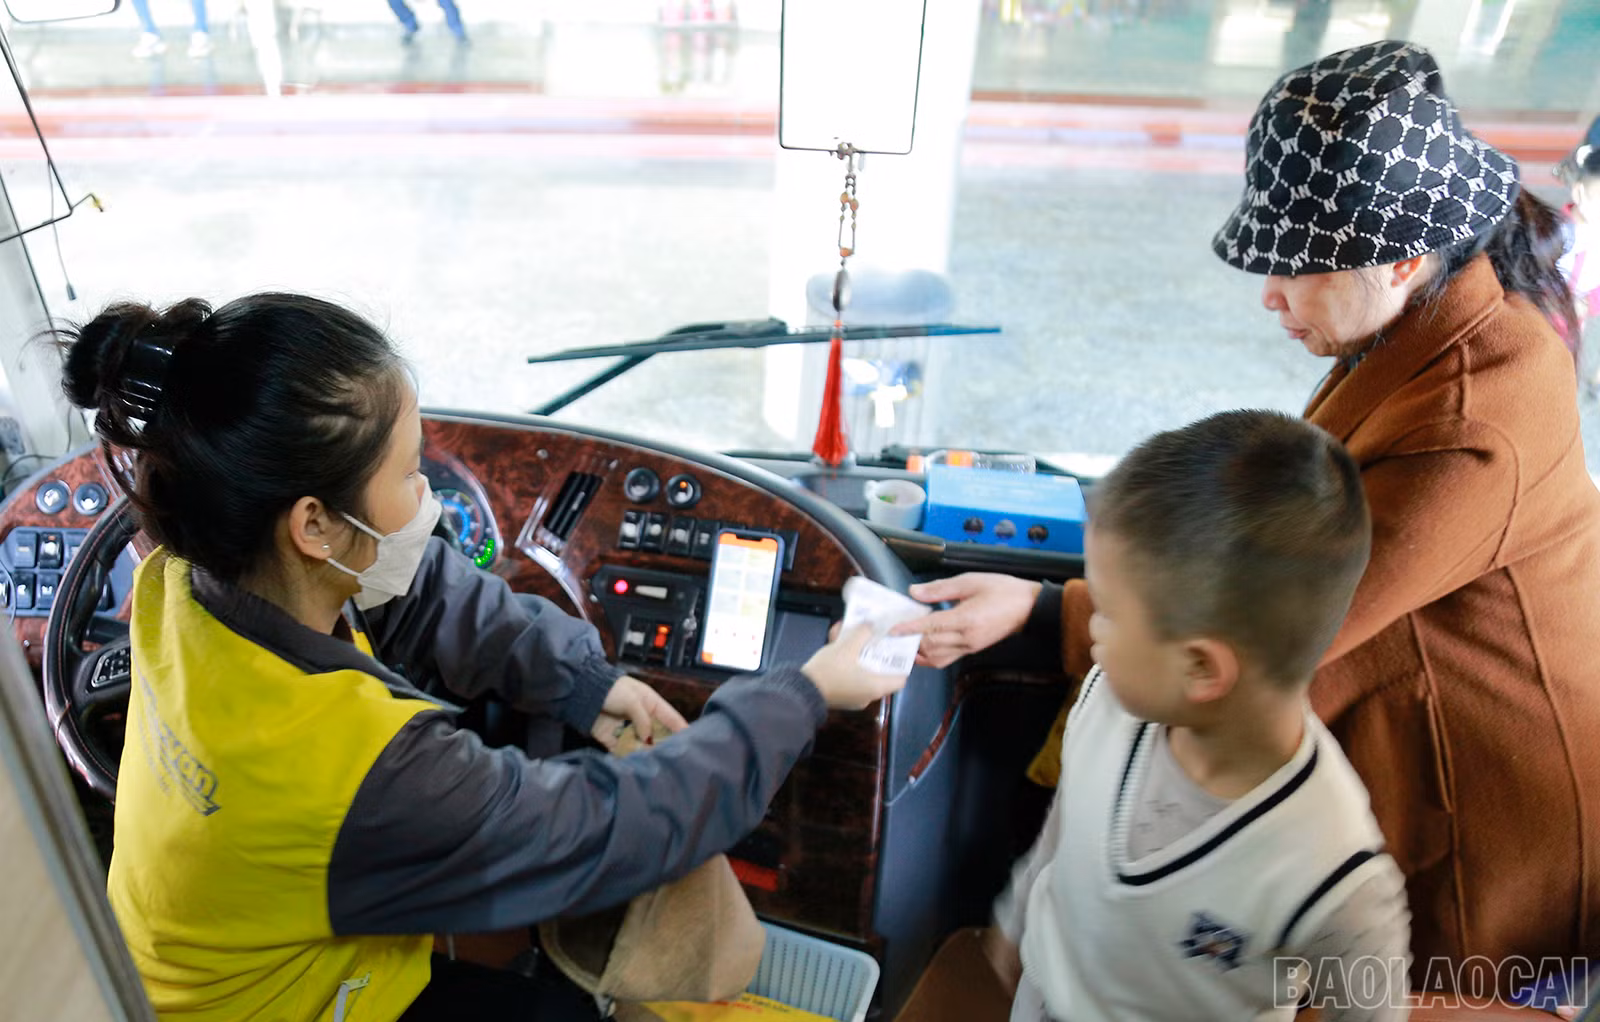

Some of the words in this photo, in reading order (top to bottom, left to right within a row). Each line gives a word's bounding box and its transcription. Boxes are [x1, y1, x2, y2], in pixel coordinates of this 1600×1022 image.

[1365, 100, 1389, 125] NY
[1336, 166, 1360, 188] NY
[1426, 184, 1451, 203] NY
[1323, 198, 1338, 214] N
[1379, 201, 1404, 221] NY
[1332, 223, 1356, 245] NY
[1290, 249, 1310, 270] NY
